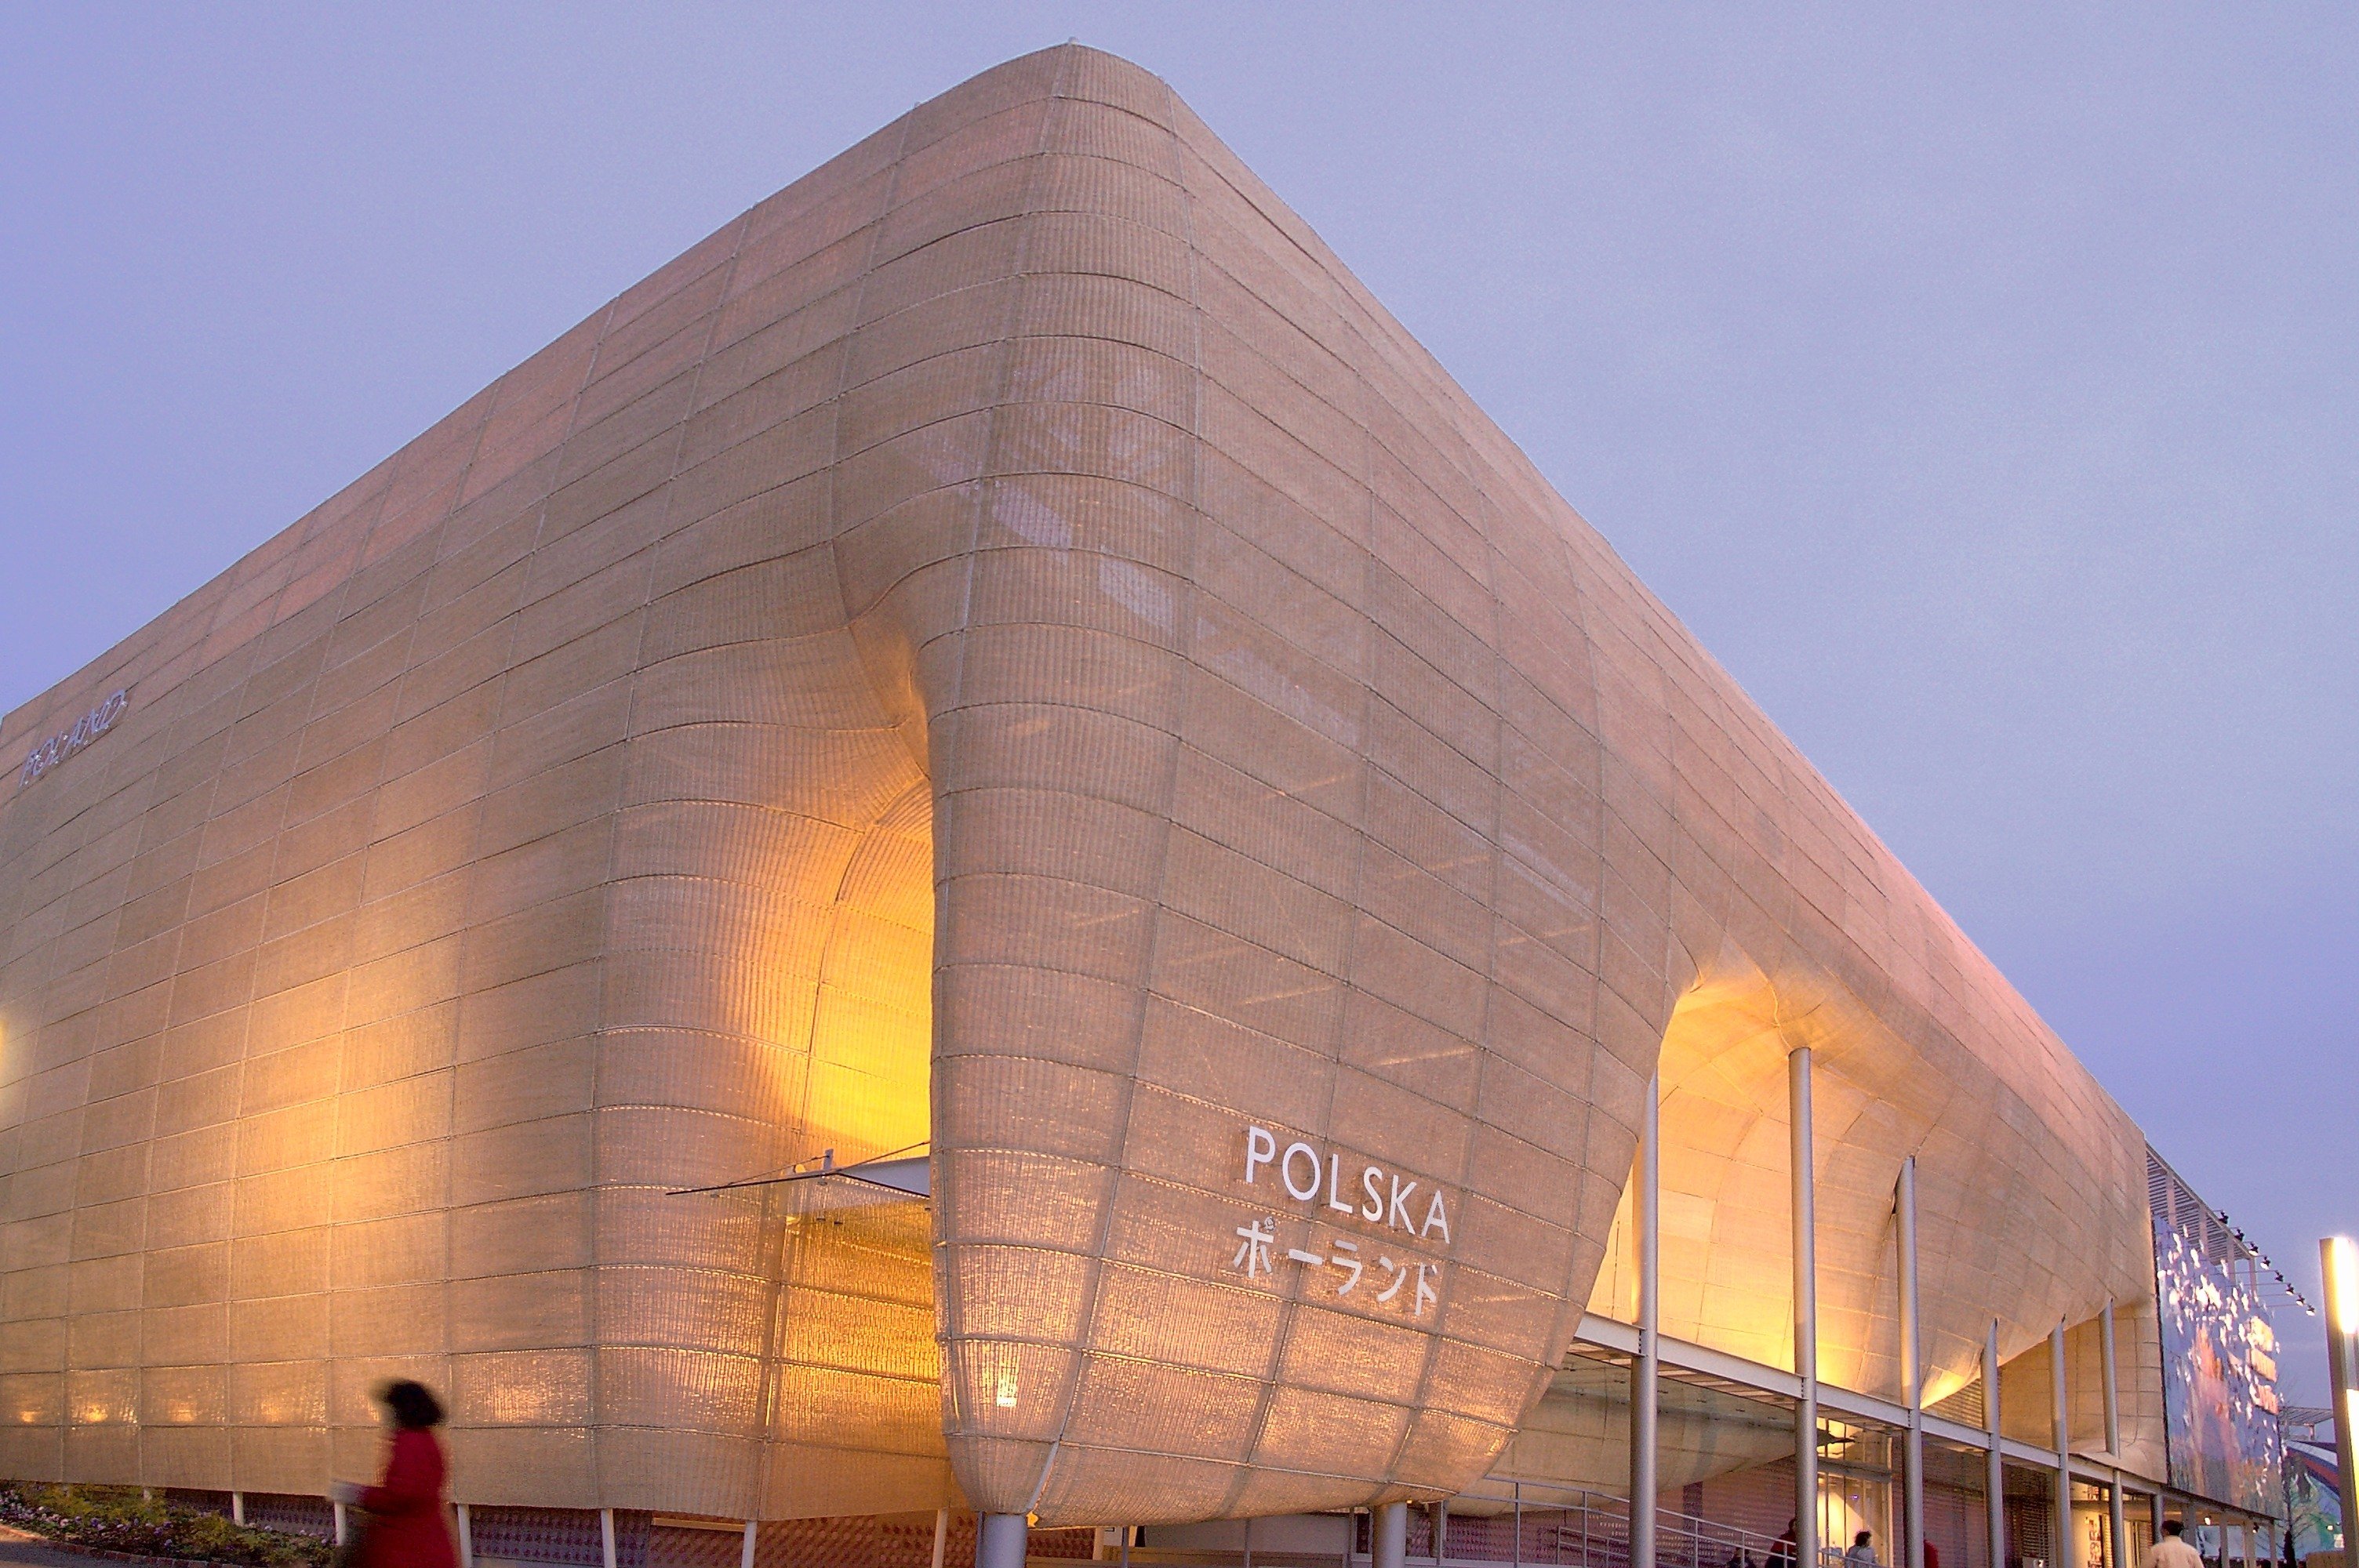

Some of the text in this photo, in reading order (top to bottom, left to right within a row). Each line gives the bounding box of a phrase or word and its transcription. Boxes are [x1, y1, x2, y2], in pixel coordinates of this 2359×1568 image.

[19, 689, 126, 788] POLAND
[1246, 1126, 1450, 1243] POLSKA
[1233, 1216, 1438, 1316] ポーランド
